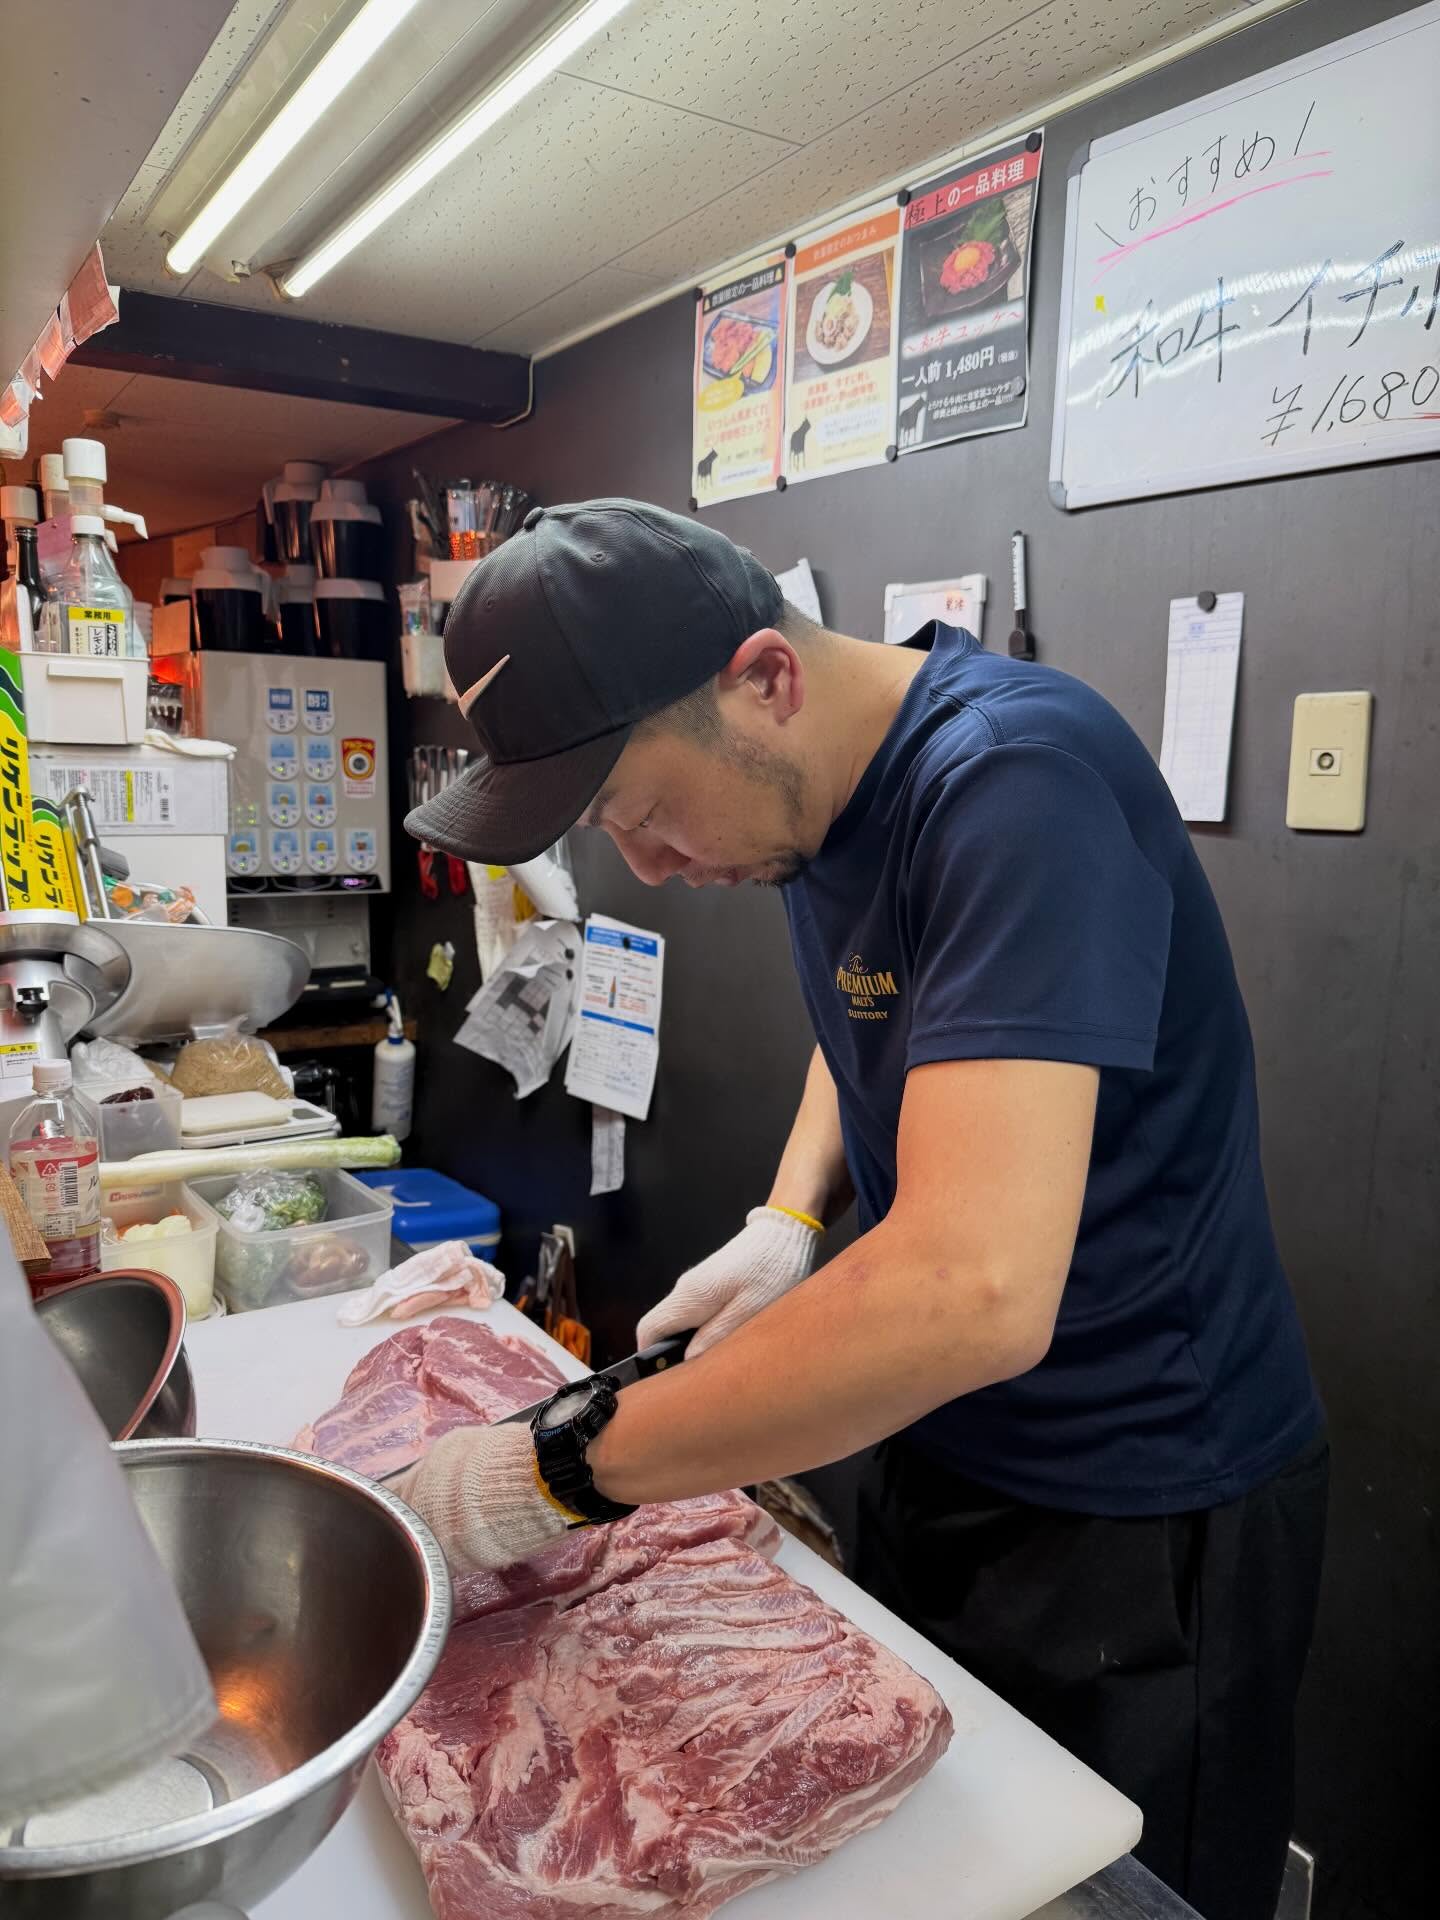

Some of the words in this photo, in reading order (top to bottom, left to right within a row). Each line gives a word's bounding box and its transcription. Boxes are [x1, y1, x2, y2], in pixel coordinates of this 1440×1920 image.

[904, 158, 1025, 228] 極上の一品料理
[902, 362, 941, 387] 一人前
[945, 344, 995, 381] 1,480円
[84, 610, 112, 620] 業務用
[1, 736, 31, 904] リケンラップ
[35, 834, 63, 908] リケンラ
[836, 965, 901, 996] PREMIUM
[848, 951, 869, 974] The
